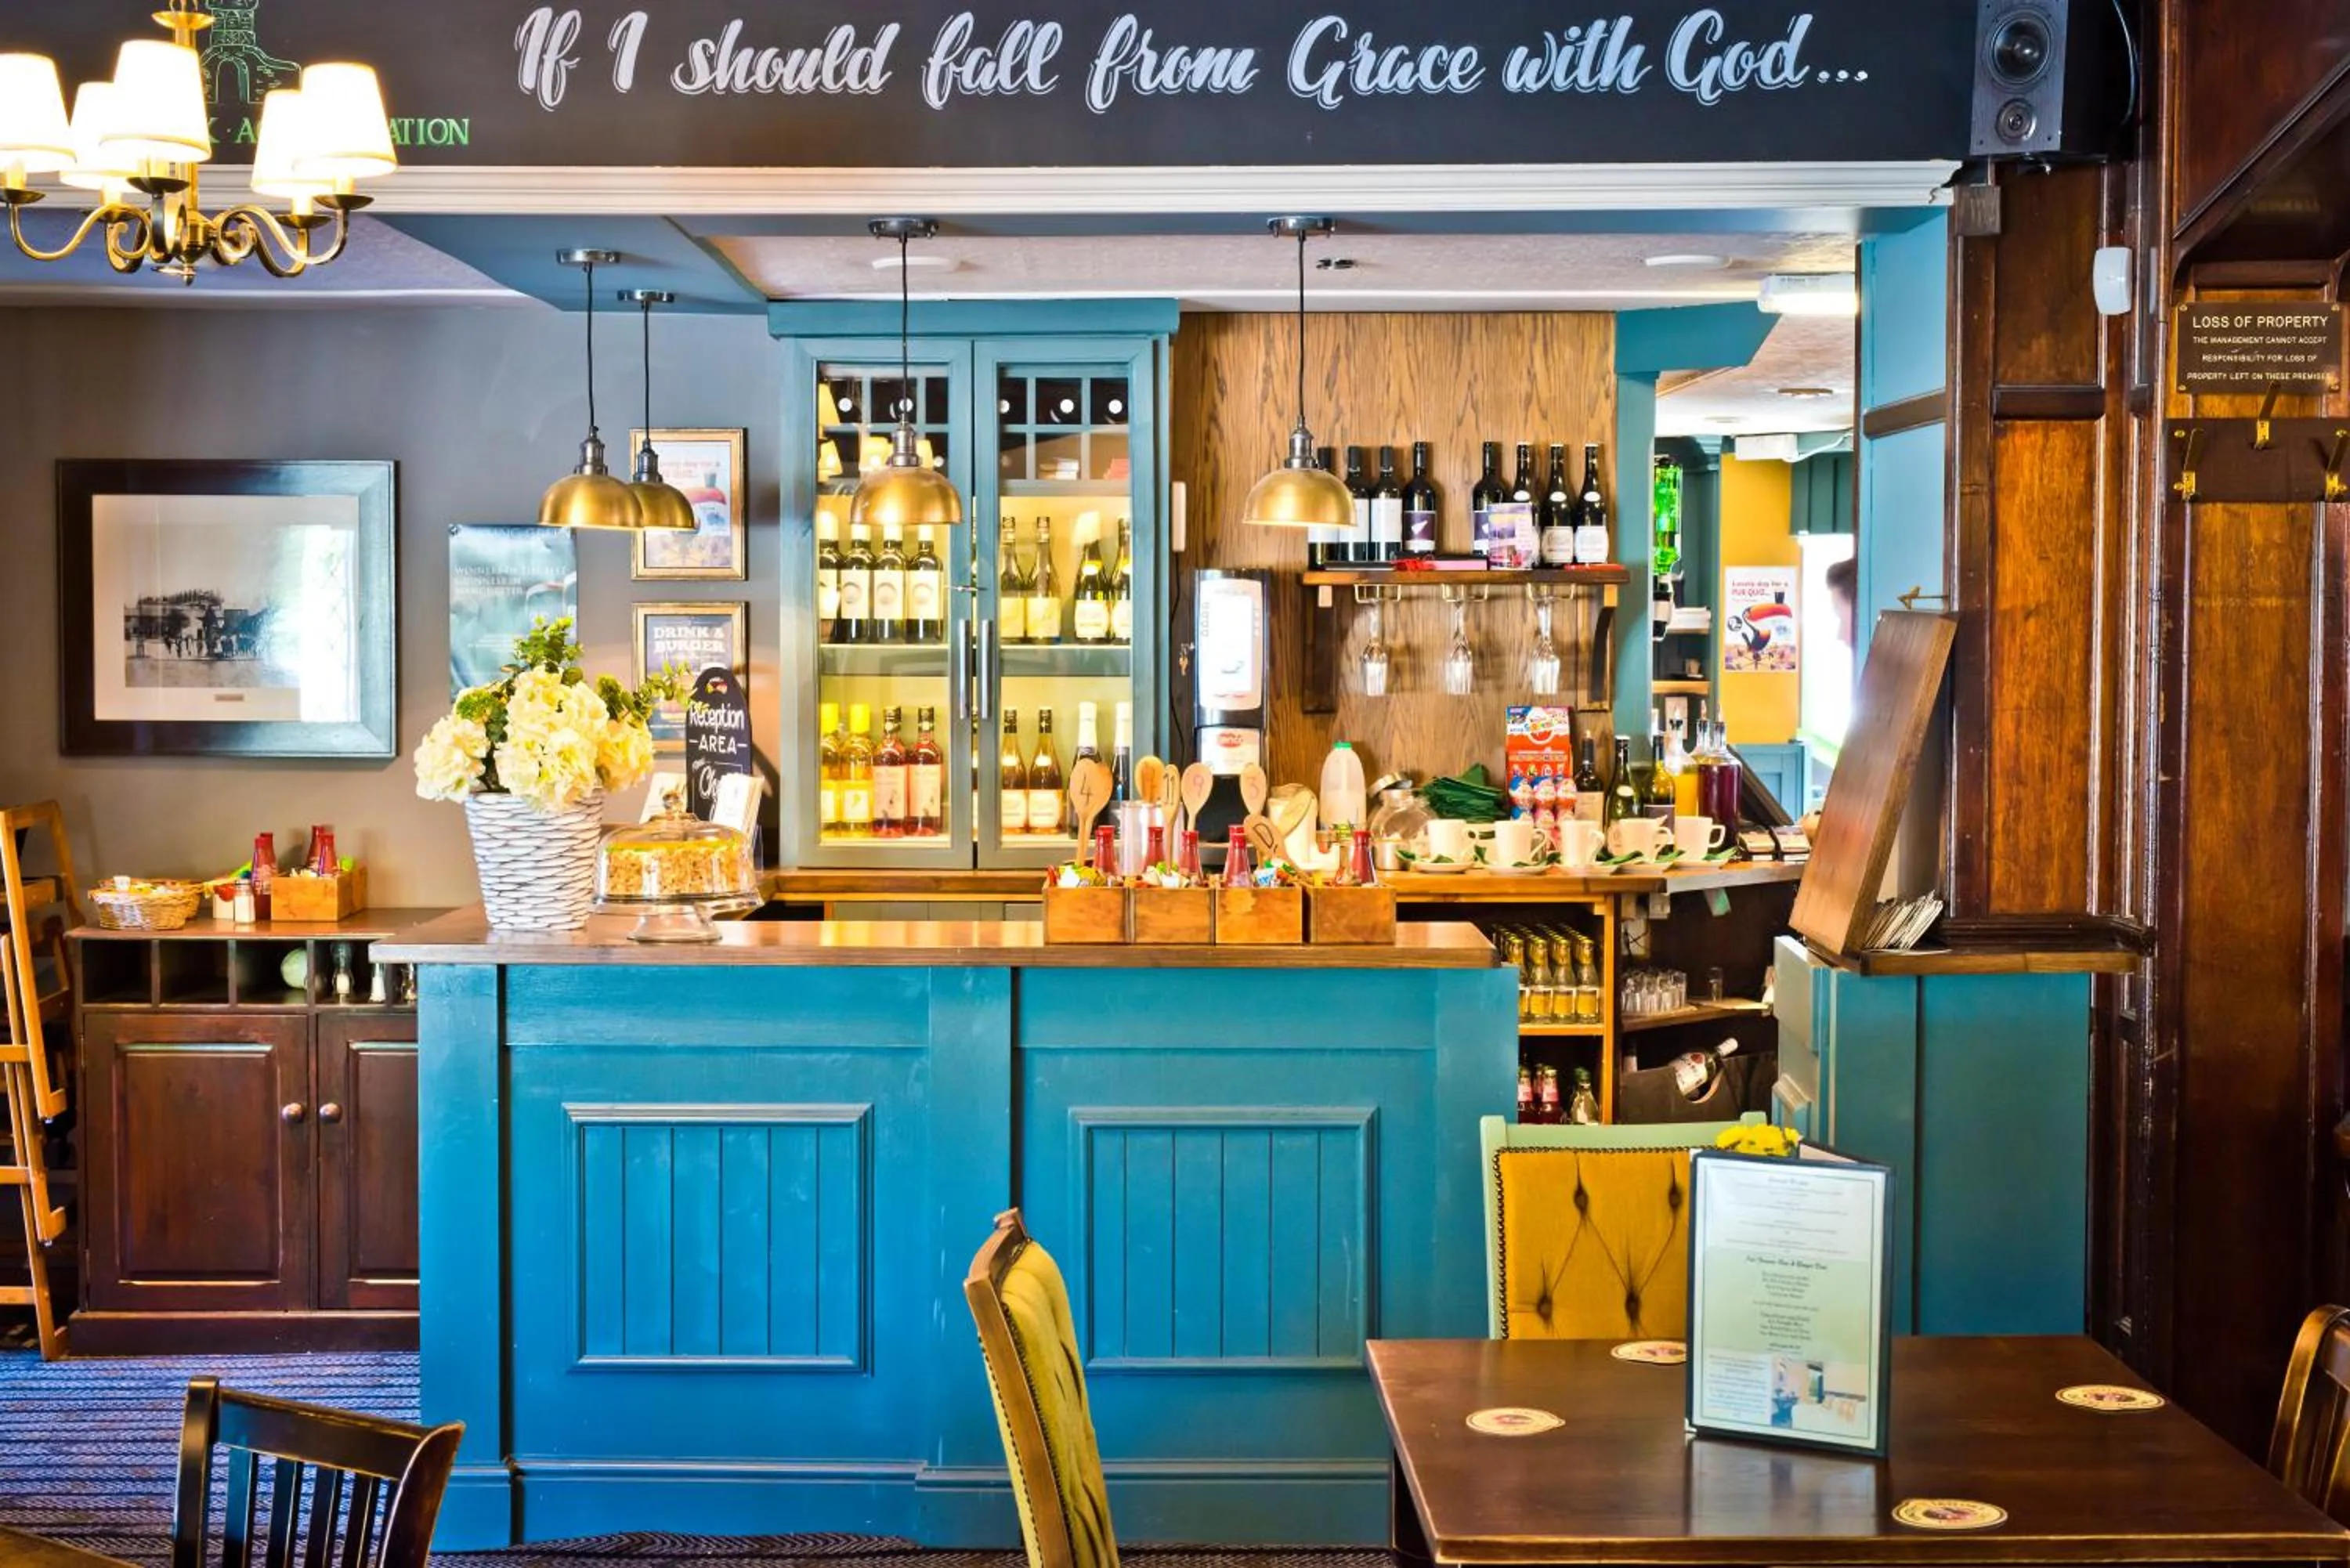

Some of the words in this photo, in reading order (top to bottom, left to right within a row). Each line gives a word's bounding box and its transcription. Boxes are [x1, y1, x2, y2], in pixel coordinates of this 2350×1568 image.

[514, 6, 581, 111] If
[607, 10, 649, 94] I
[670, 18, 901, 96] should
[921, 11, 1063, 110] fall
[1085, 13, 1260, 114] from
[1287, 15, 1486, 111] Grace
[1502, 15, 1652, 93] with
[2193, 316, 2230, 328] LOSS
[2233, 316, 2253, 328] OF
[2257, 316, 2328, 328] PROPERTY
[2210, 336, 2264, 345] MANAGEMENT
[2265, 336, 2297, 345] CANNOT
[2298, 336, 2327, 345] ACCEPT
[2202, 354, 2265, 363] RESPONSIBILITY
[2267, 354, 2283, 363] FOR
[2285, 354, 2305, 363] LOSS
[653, 627, 708, 639] DRINK
[714, 627, 725, 638] &
[653, 640, 726, 653] BURGER
[689, 701, 744, 733] Reception
[698, 735, 737, 755] AREA
